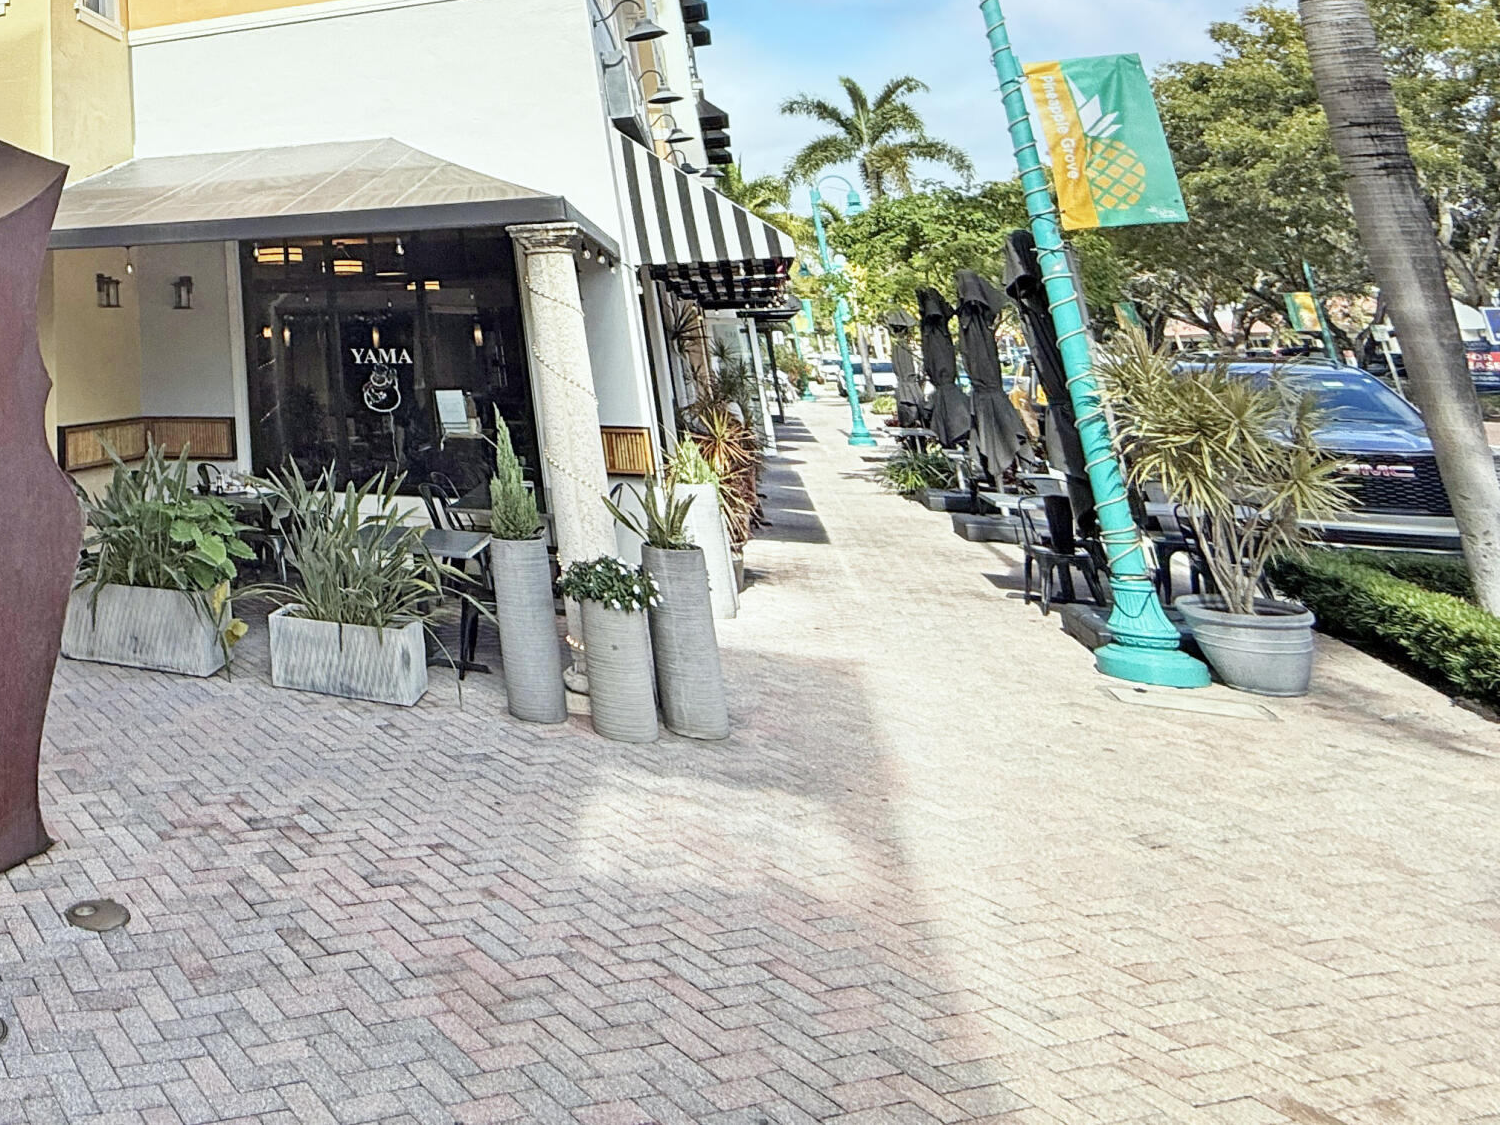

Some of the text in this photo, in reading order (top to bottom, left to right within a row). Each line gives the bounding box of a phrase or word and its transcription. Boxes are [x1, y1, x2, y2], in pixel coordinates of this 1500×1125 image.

[1060, 137, 1080, 179] Grove
[350, 348, 413, 364] YAMA
[1335, 463, 1416, 477] GMC
